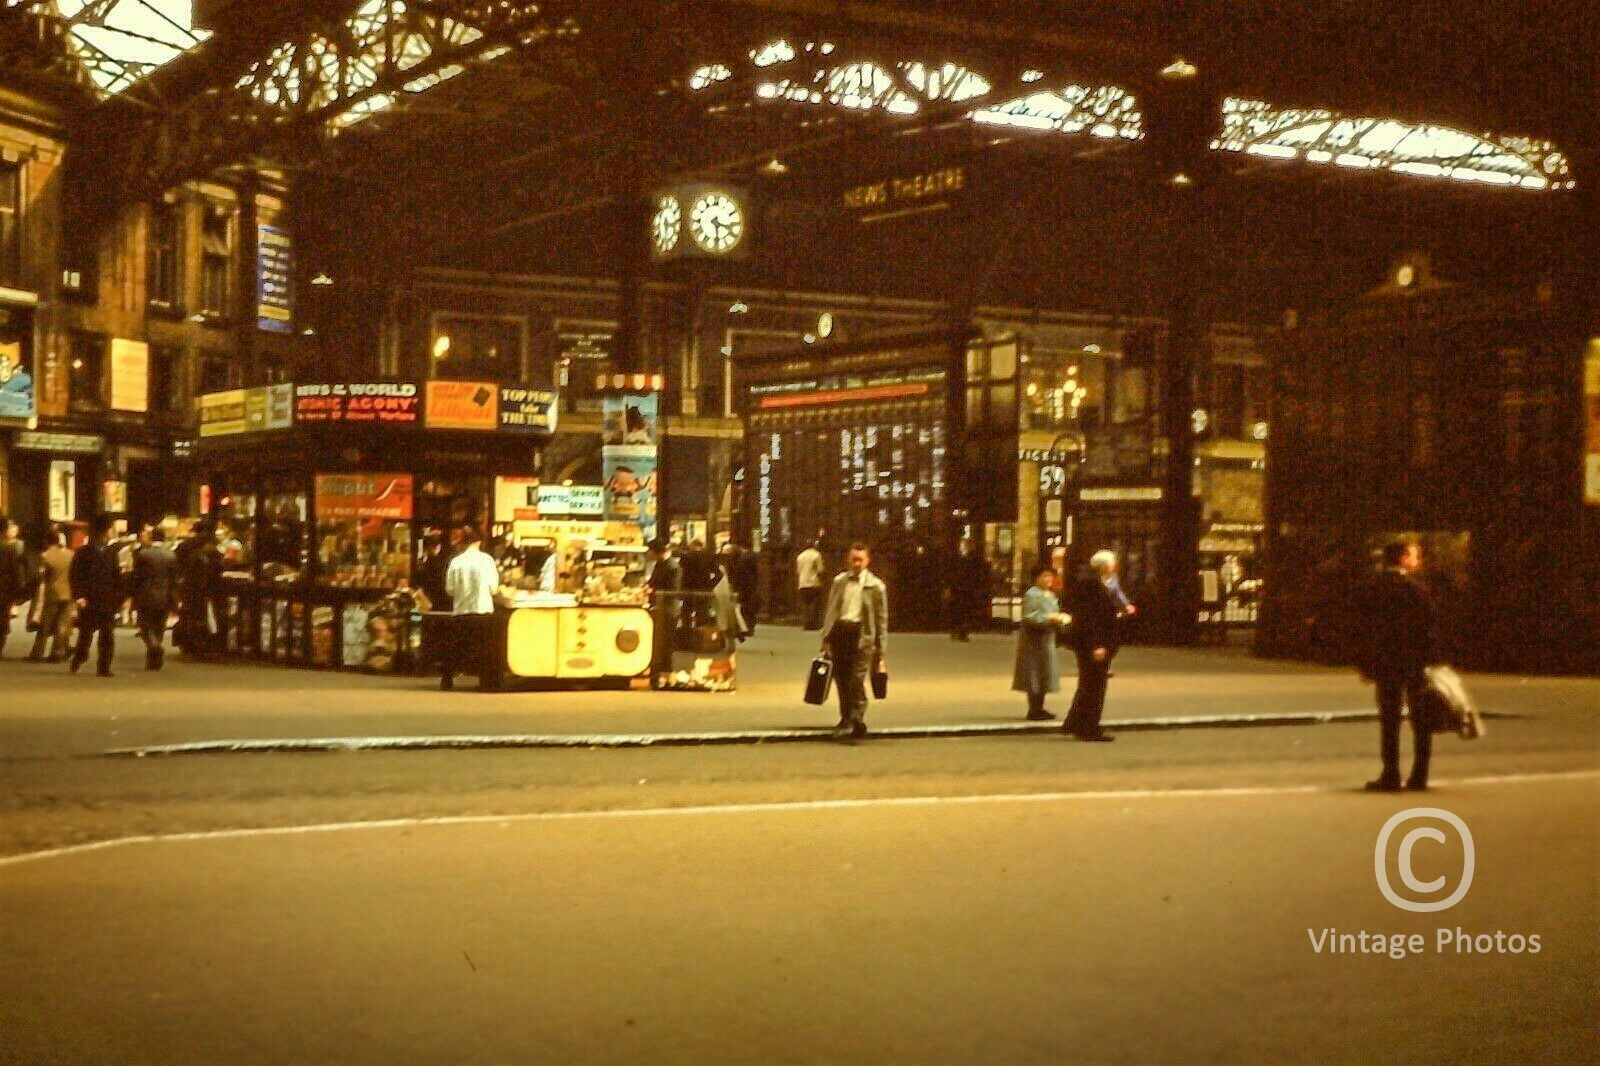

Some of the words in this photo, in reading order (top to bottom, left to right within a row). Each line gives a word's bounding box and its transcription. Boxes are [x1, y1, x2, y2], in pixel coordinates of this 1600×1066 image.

[893, 168, 964, 200] THEATRE
[348, 383, 416, 397] WORLD
[501, 388, 527, 401] TOP
[541, 525, 561, 534] TEA
[570, 525, 593, 534] BAR
